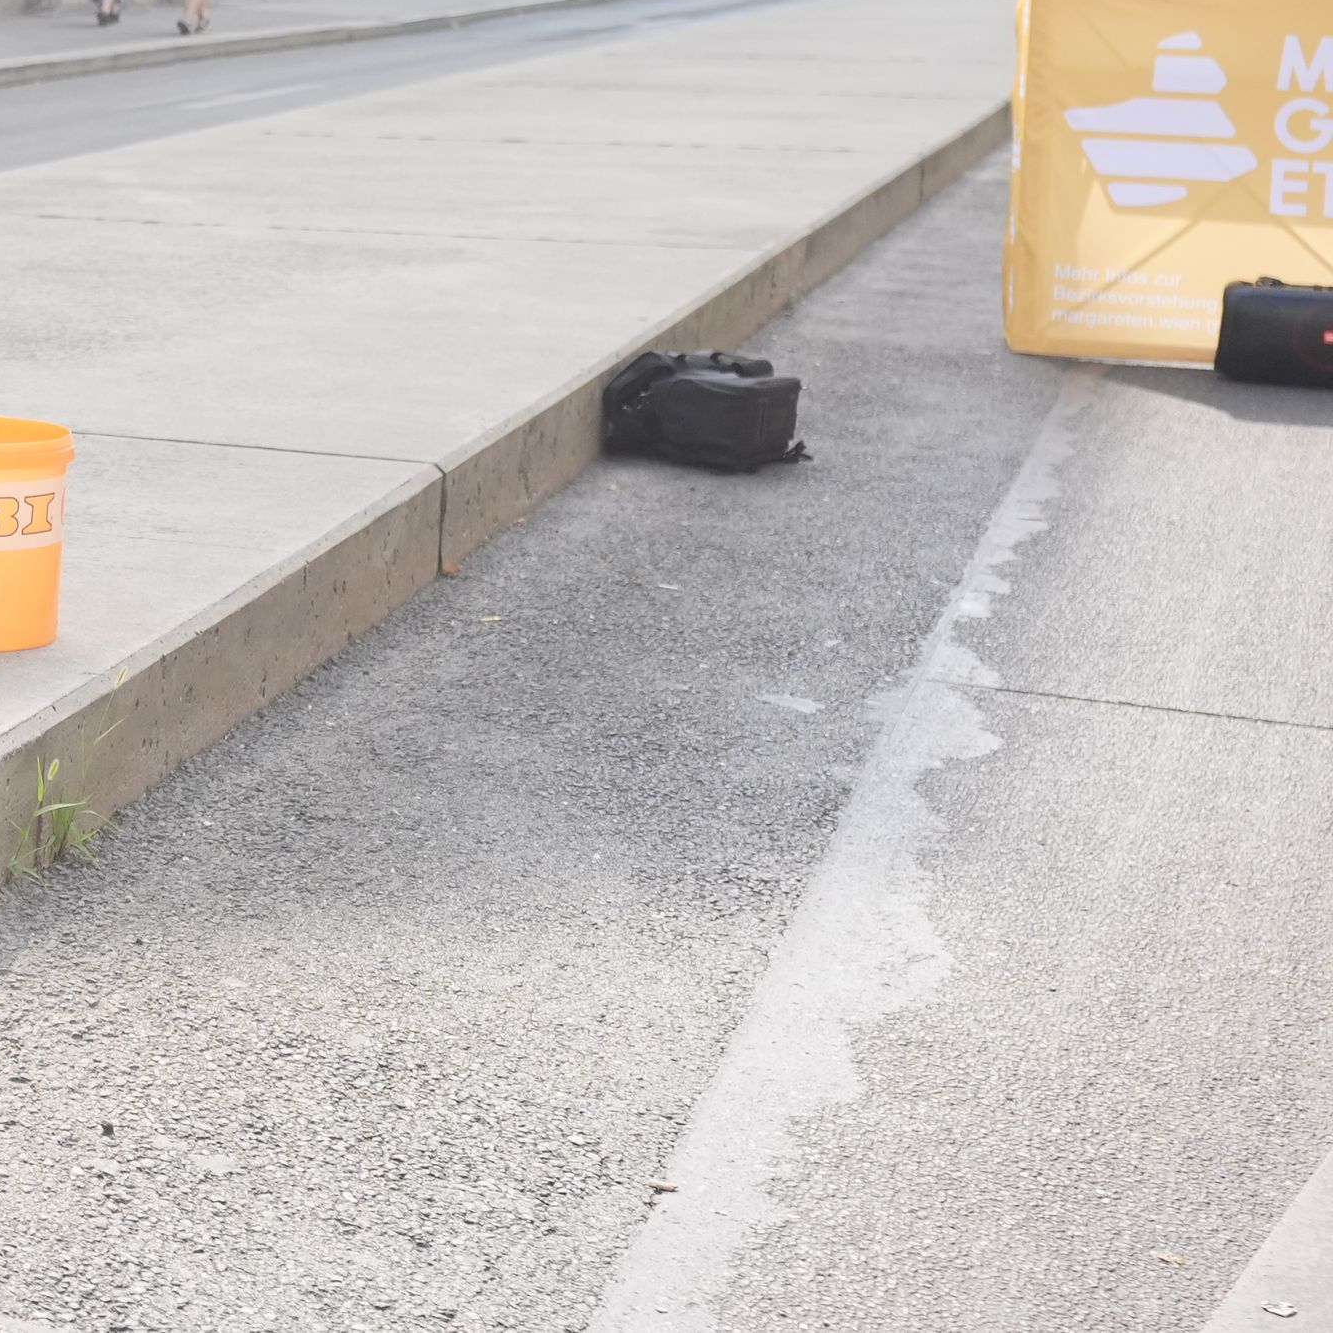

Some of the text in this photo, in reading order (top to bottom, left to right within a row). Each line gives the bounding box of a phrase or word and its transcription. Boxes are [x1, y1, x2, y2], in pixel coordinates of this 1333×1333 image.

[1275, 34, 1333, 94] M
[1273, 96, 1333, 155] G
[1054, 265, 1181, 287] Mehr Infos zur
